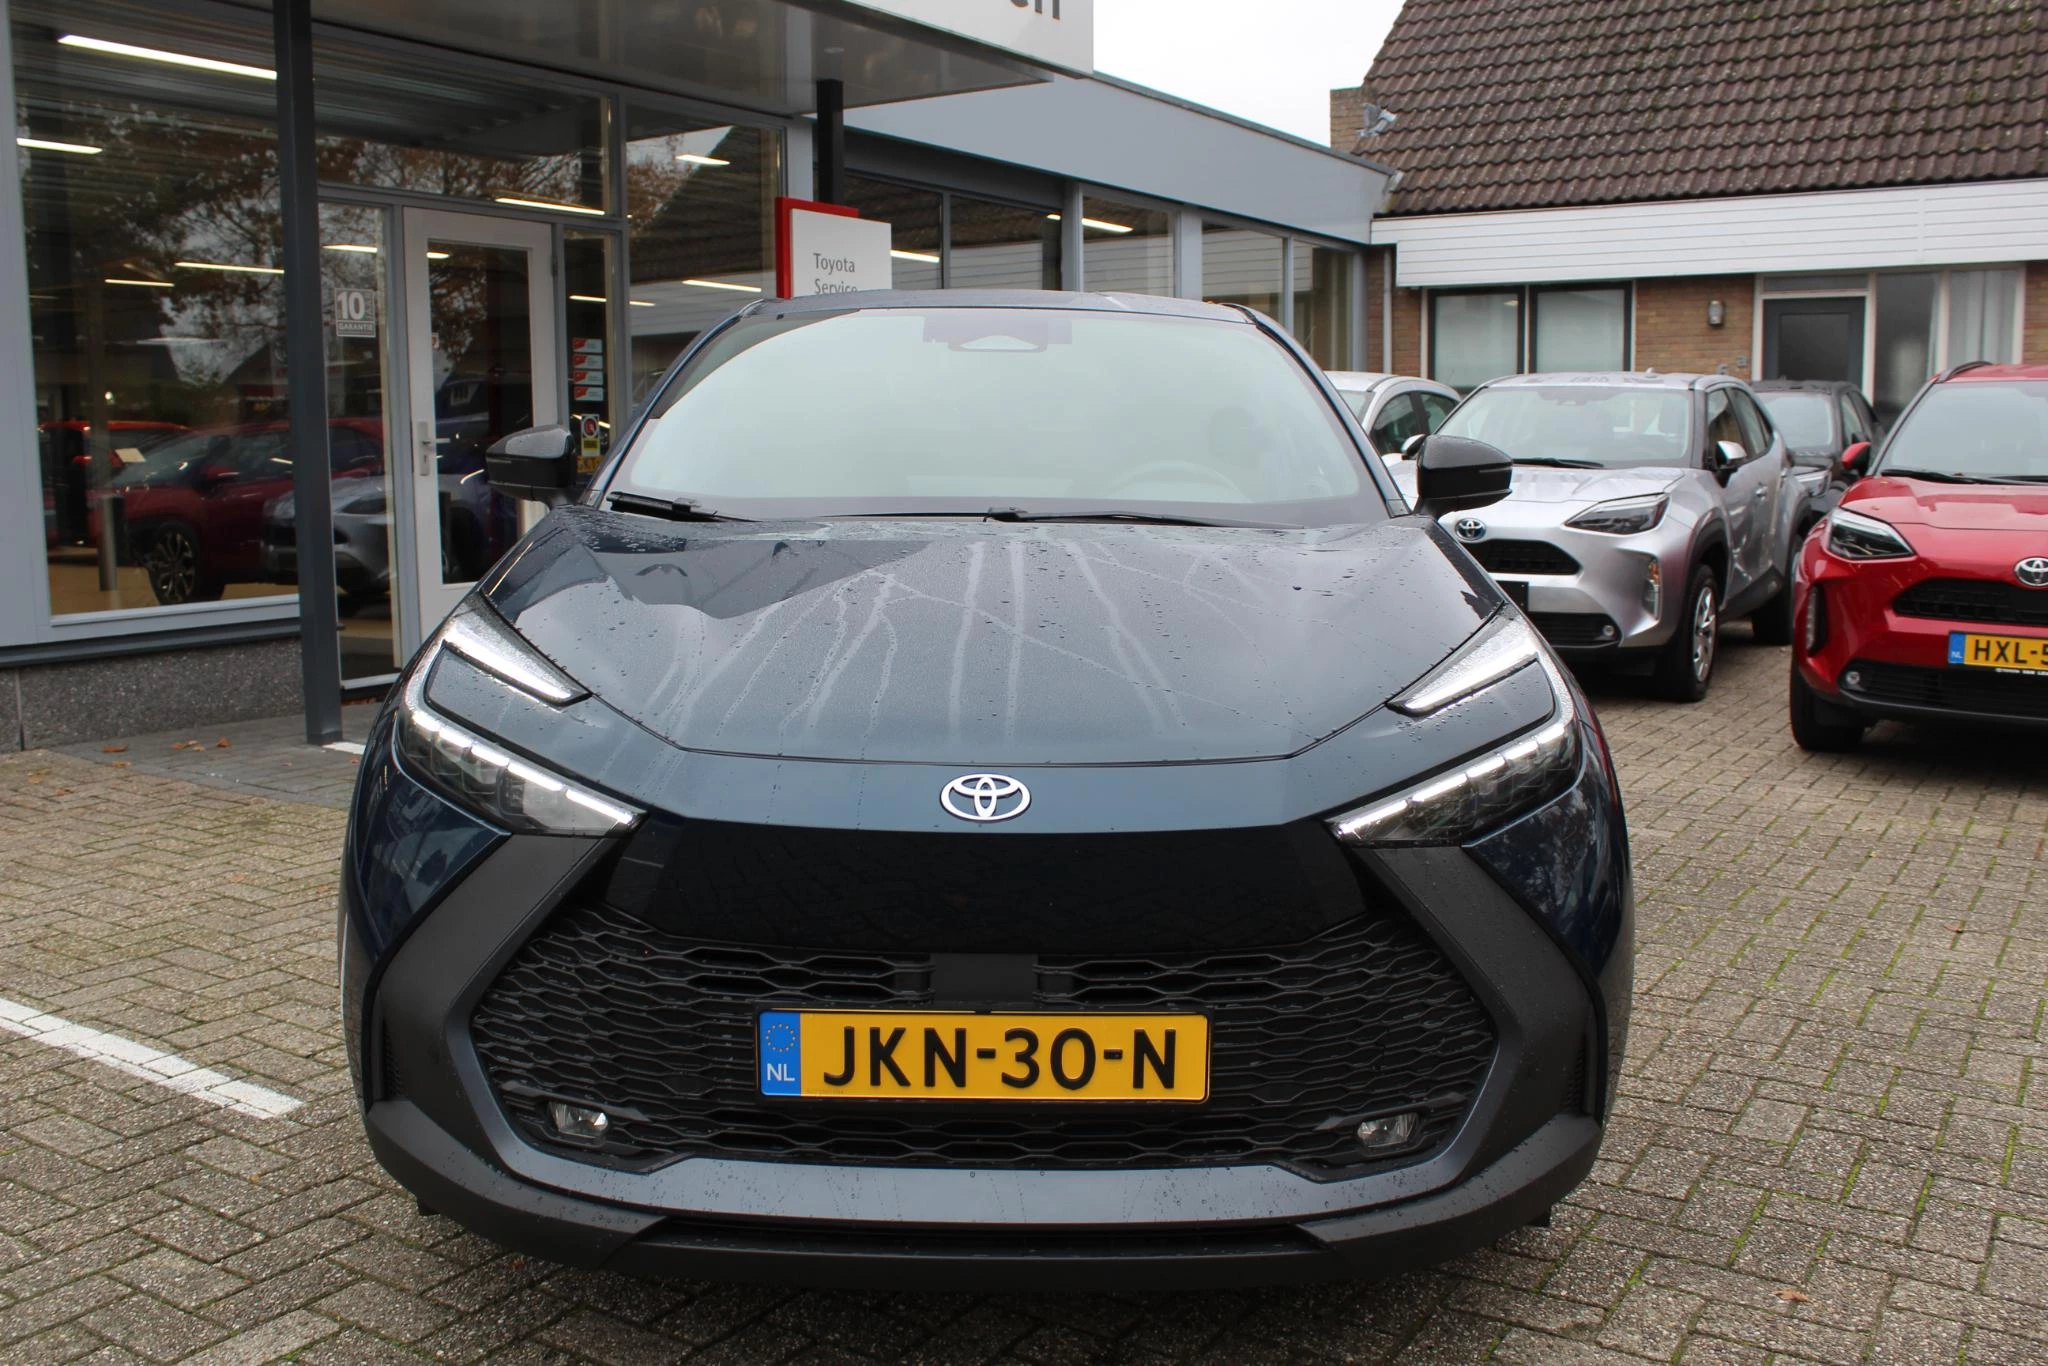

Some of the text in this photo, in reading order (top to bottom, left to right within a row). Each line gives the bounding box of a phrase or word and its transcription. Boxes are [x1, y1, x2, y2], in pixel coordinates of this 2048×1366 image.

[813, 253, 856, 276] Toyota
[337, 291, 365, 320] 10
[823, 1025, 1176, 1091] JKN-30-N
[767, 1063, 795, 1082] NL
